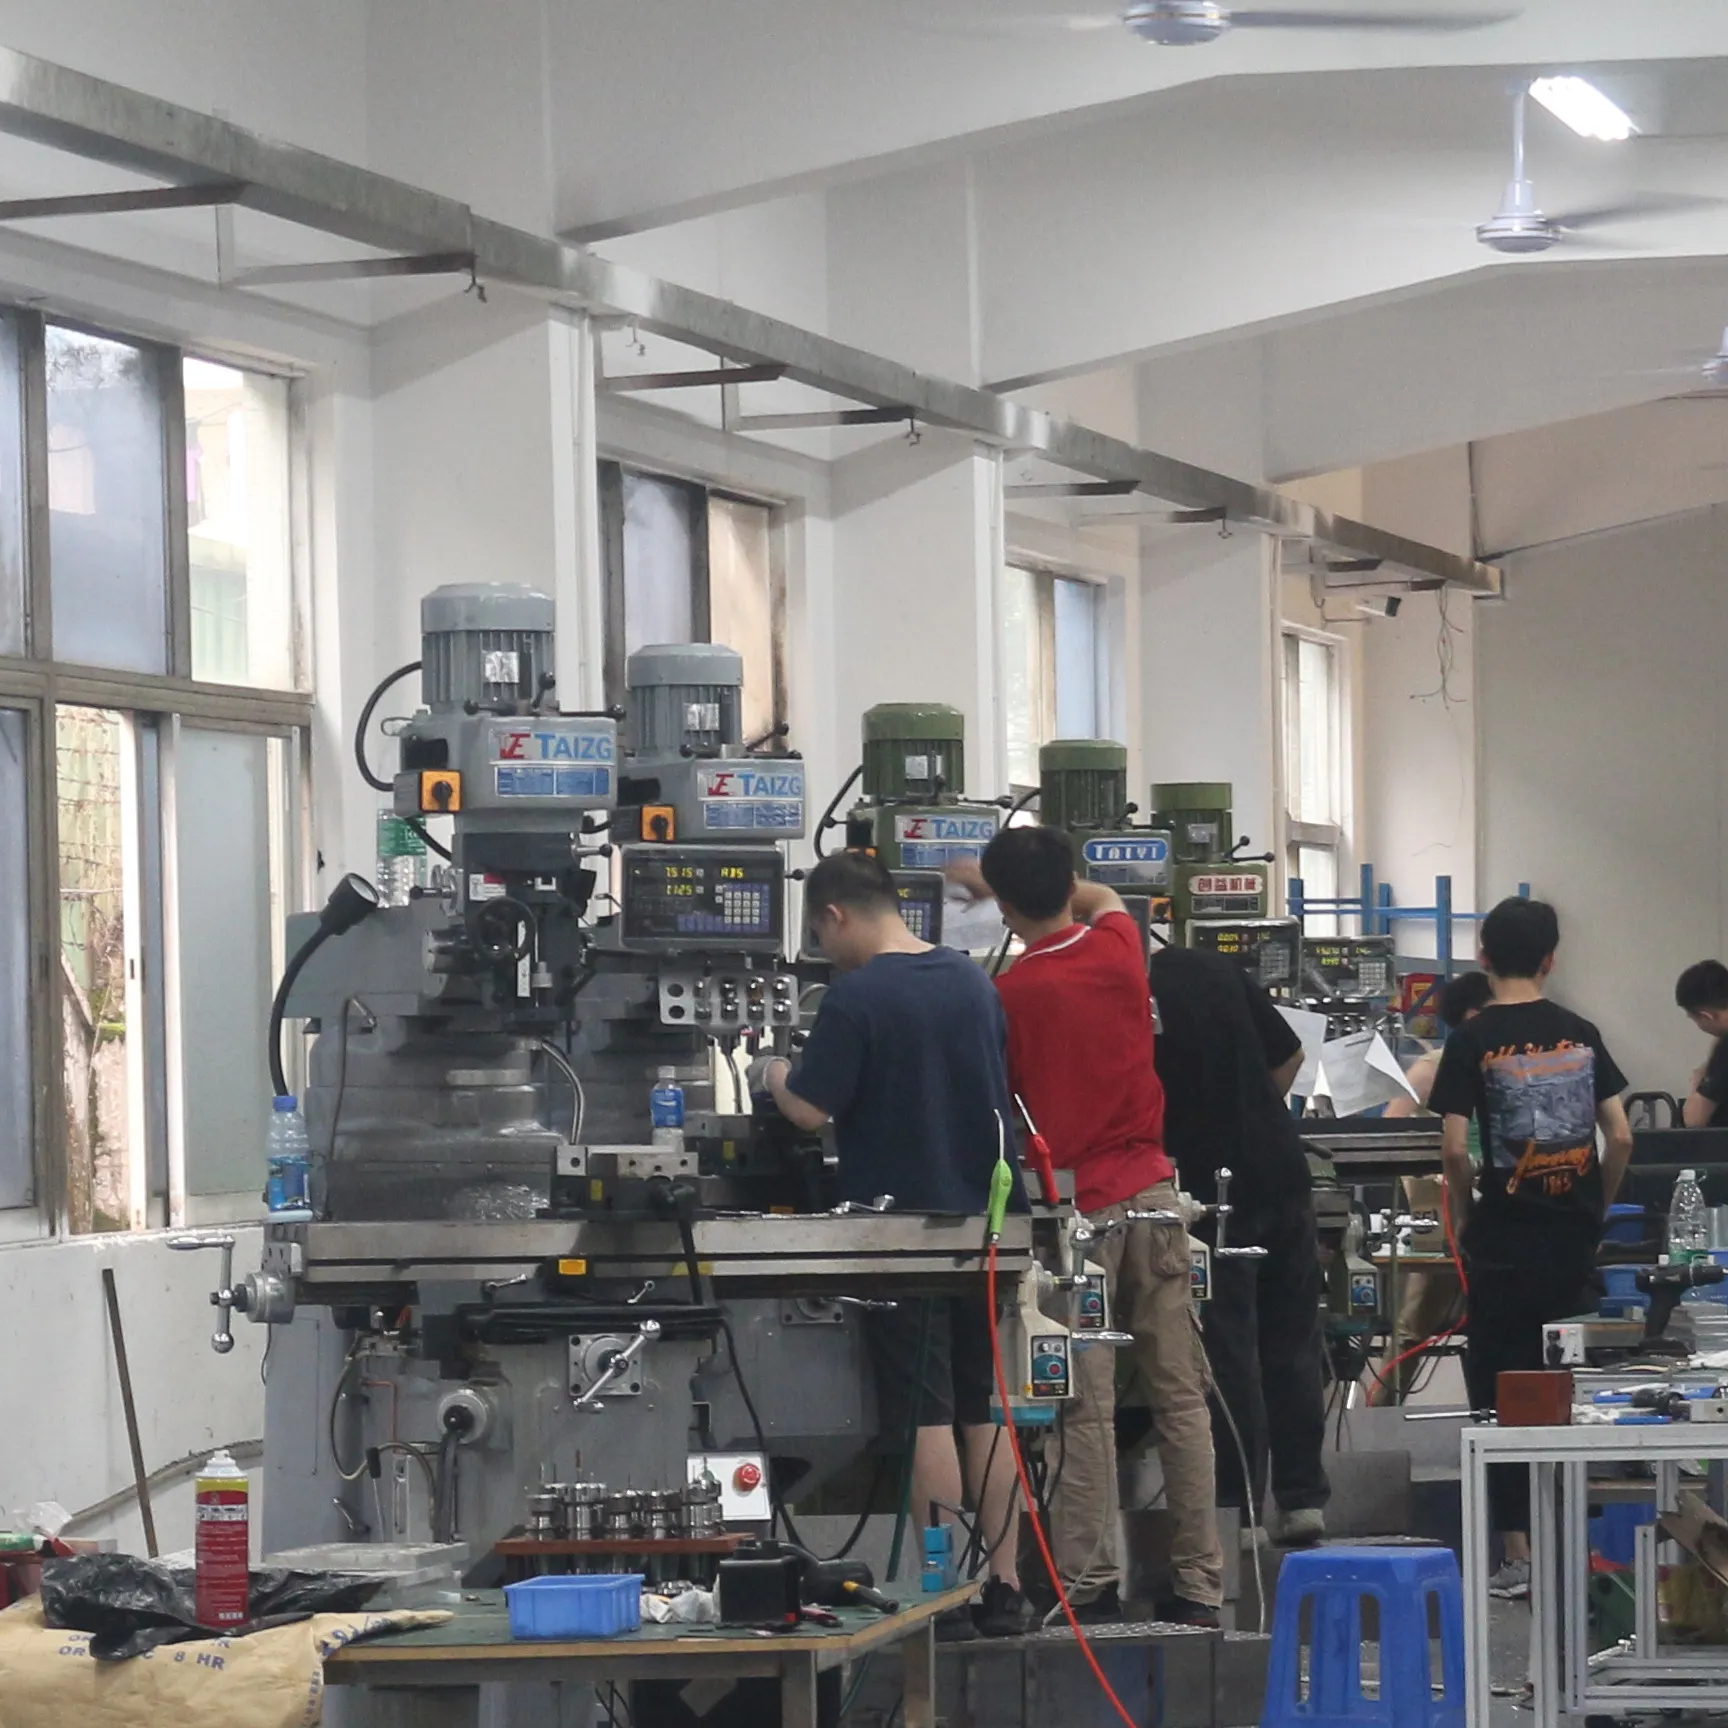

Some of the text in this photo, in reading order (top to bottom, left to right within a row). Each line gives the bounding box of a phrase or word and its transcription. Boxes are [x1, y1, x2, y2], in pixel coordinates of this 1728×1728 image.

[534, 732, 613, 759] TAIZG
[737, 773, 802, 796] TAIZG
[930, 818, 993, 839] TAIZG
[196, 1653, 226, 1670] HR
